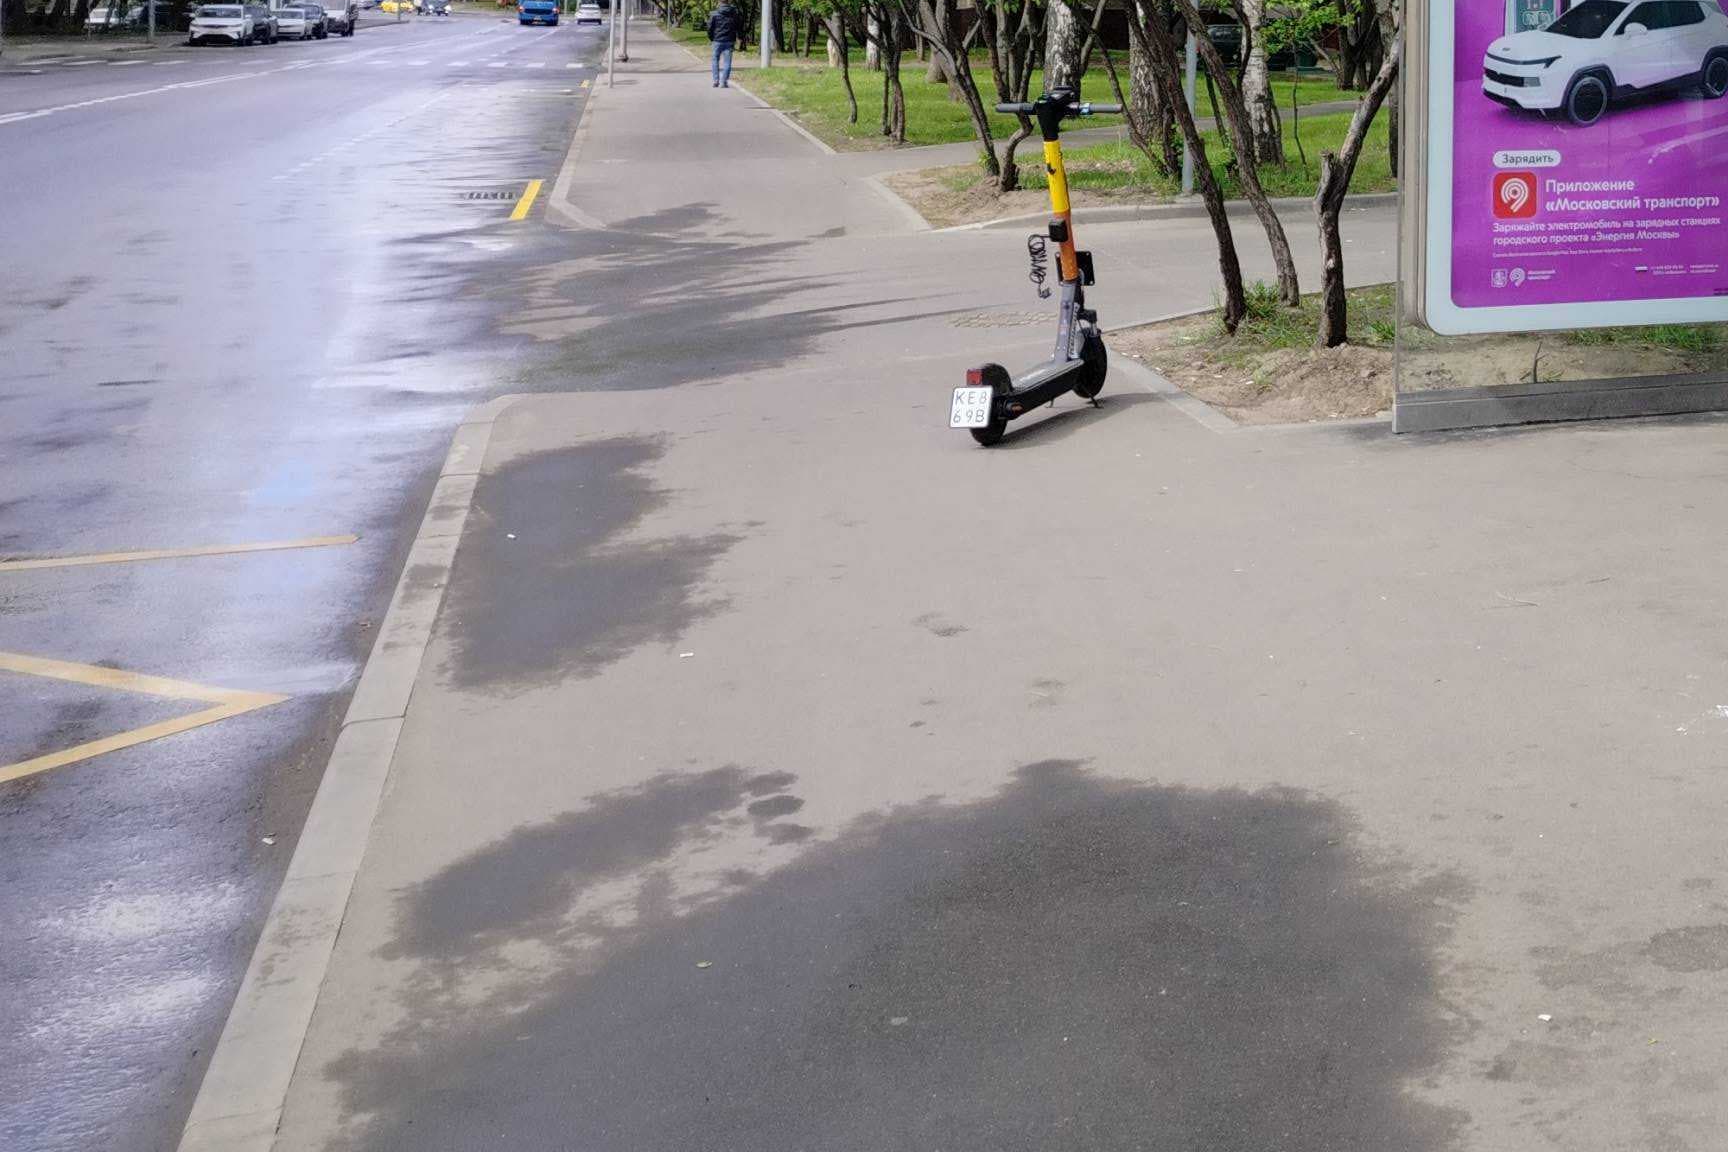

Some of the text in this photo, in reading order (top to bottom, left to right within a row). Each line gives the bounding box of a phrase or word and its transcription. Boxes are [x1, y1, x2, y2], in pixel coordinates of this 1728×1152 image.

[1502, 154, 1554, 165] Зарядить
[1545, 179, 1635, 195] Приложение
[1545, 196, 1720, 212] «Московский транспорт»
[1492, 217, 1720, 234] Заряжайте электромобиль на зарядных станциях
[1493, 230, 1680, 246] городского проекта «Энергия Москвы»
